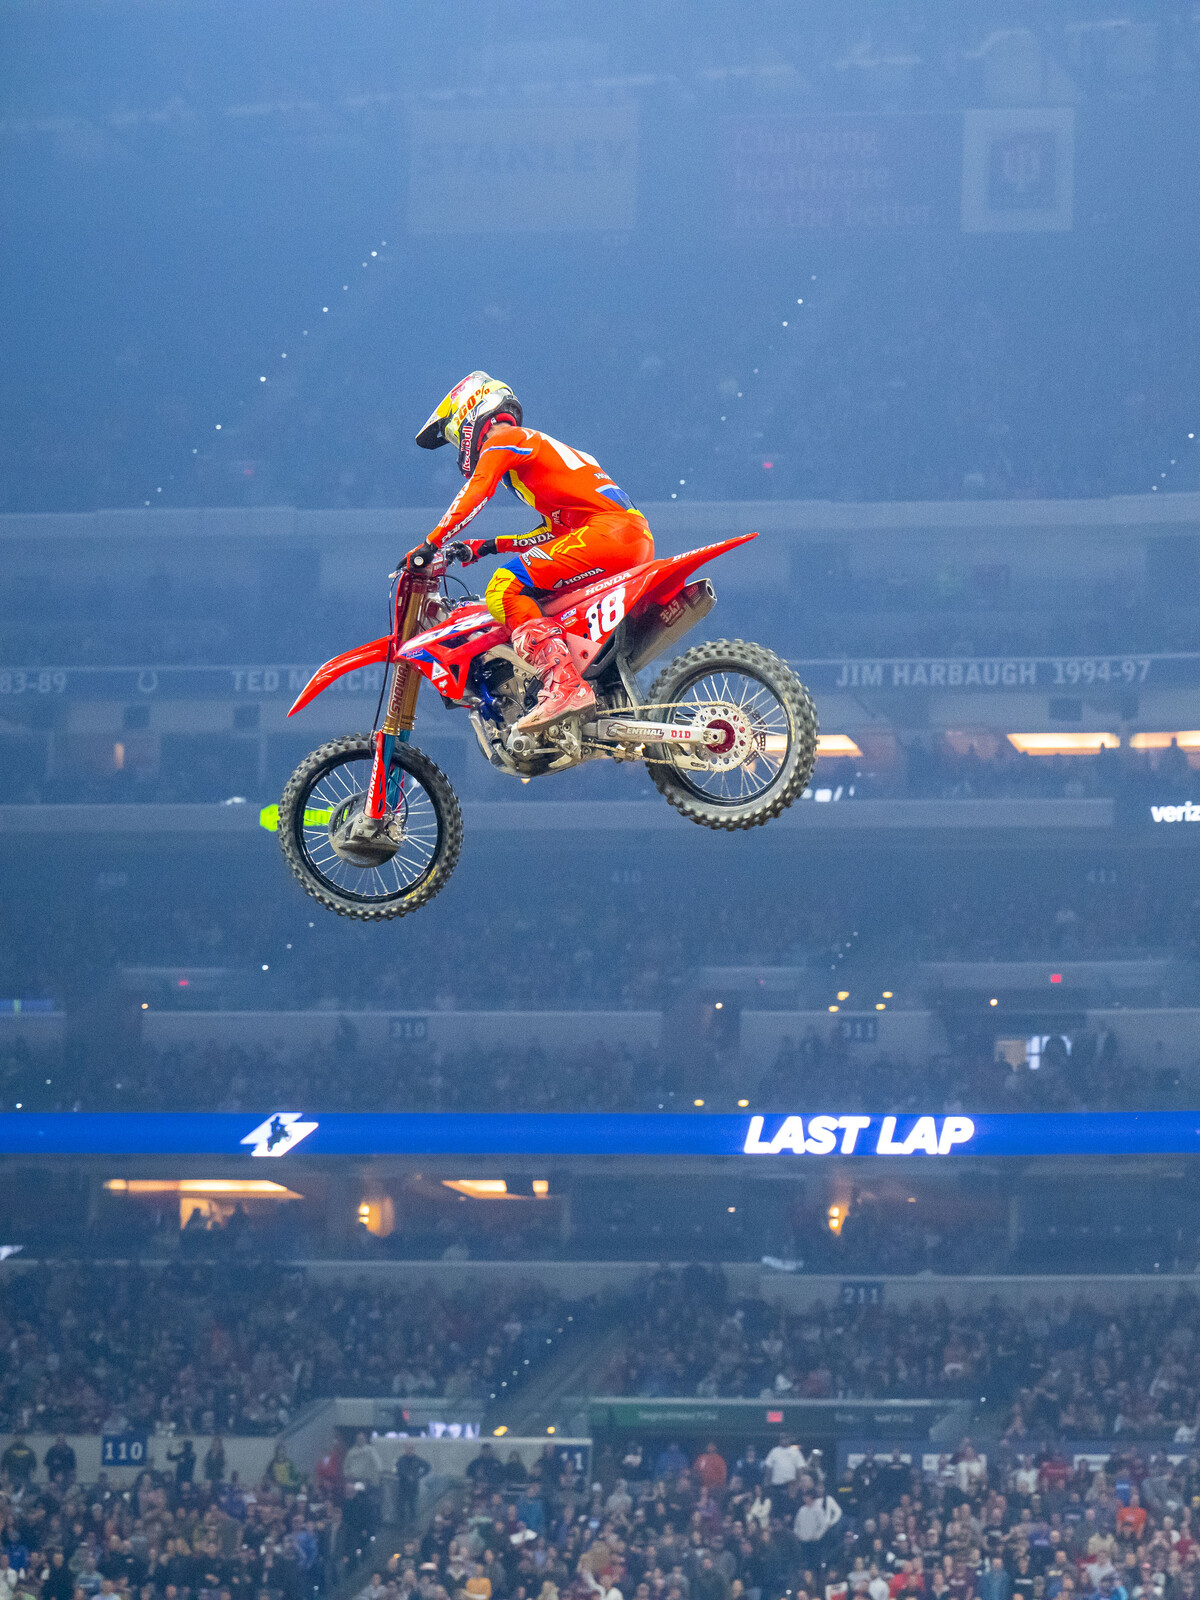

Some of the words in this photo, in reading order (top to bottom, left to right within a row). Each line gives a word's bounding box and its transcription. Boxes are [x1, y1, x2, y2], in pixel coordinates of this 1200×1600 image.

[734, 125, 880, 158] Changing
[417, 138, 630, 177] STANLEY
[733, 161, 890, 192] healthcare
[782, 201, 835, 230] the
[564, 567, 605, 585] HONDA
[585, 572, 632, 596] HONDA
[585, 586, 626, 642] 18
[0, 671, 67, 694] 83-89
[232, 669, 278, 692] TED
[836, 664, 883, 687] JIM
[892, 662, 1036, 686] HARBAUGH
[1052, 659, 1151, 684] 1994-97
[390, 664, 410, 718] SHOWA
[366, 752, 380, 807] DUNLOP
[389, 1020, 426, 1040] 310
[841, 1020, 877, 1039] 311
[743, 1116, 871, 1155] LAST
[876, 1116, 975, 1155] LAP
[843, 1284, 880, 1305] 211
[104, 1442, 144, 1462] 110
